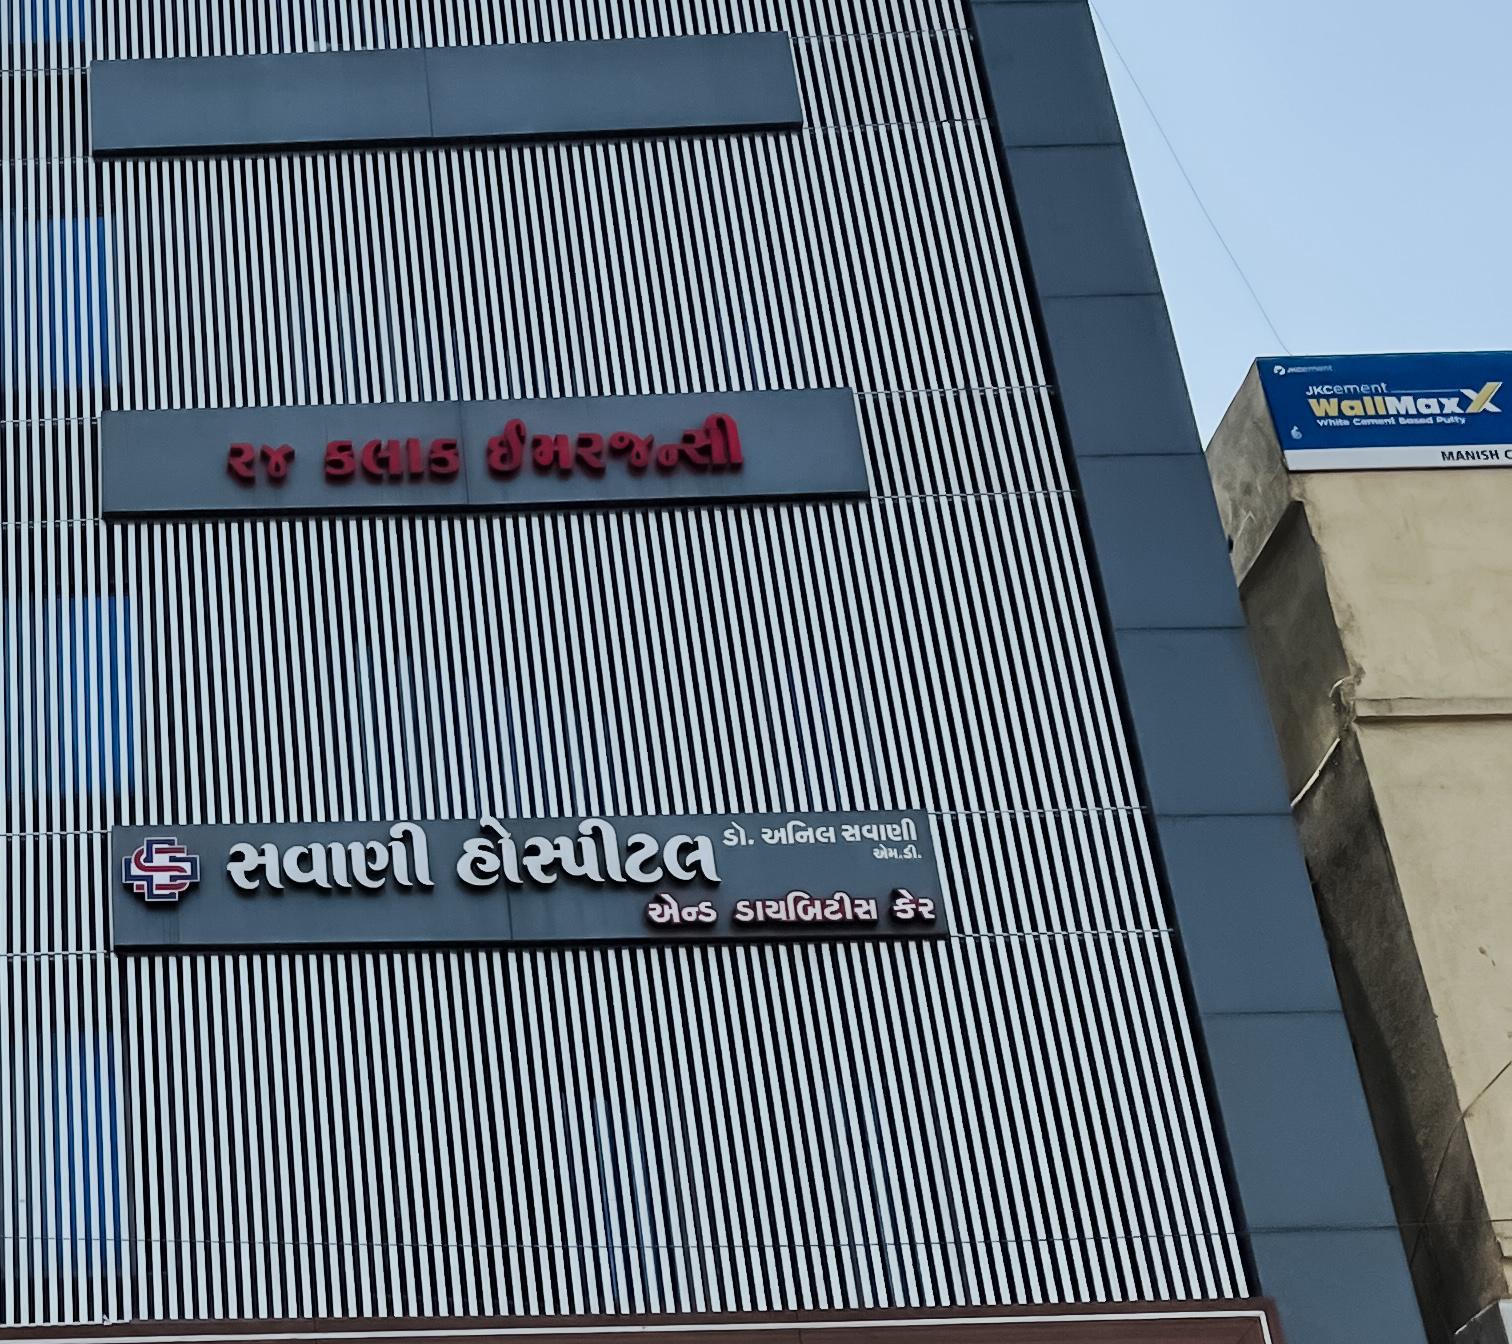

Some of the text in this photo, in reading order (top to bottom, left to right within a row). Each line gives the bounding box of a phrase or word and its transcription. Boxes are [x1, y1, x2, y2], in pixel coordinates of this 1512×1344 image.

[1316, 415, 1466, 427] White Cement Based Putty
[325, 436, 462, 478] કલાક
[1441, 449, 1499, 462] MANISH
[761, 820, 837, 844] અનિલ
[841, 817, 918, 842] સવાણી
[226, 822, 434, 890] સવાણી
[648, 888, 936, 923] એન્ડ ડાયબિટીસ કેર
